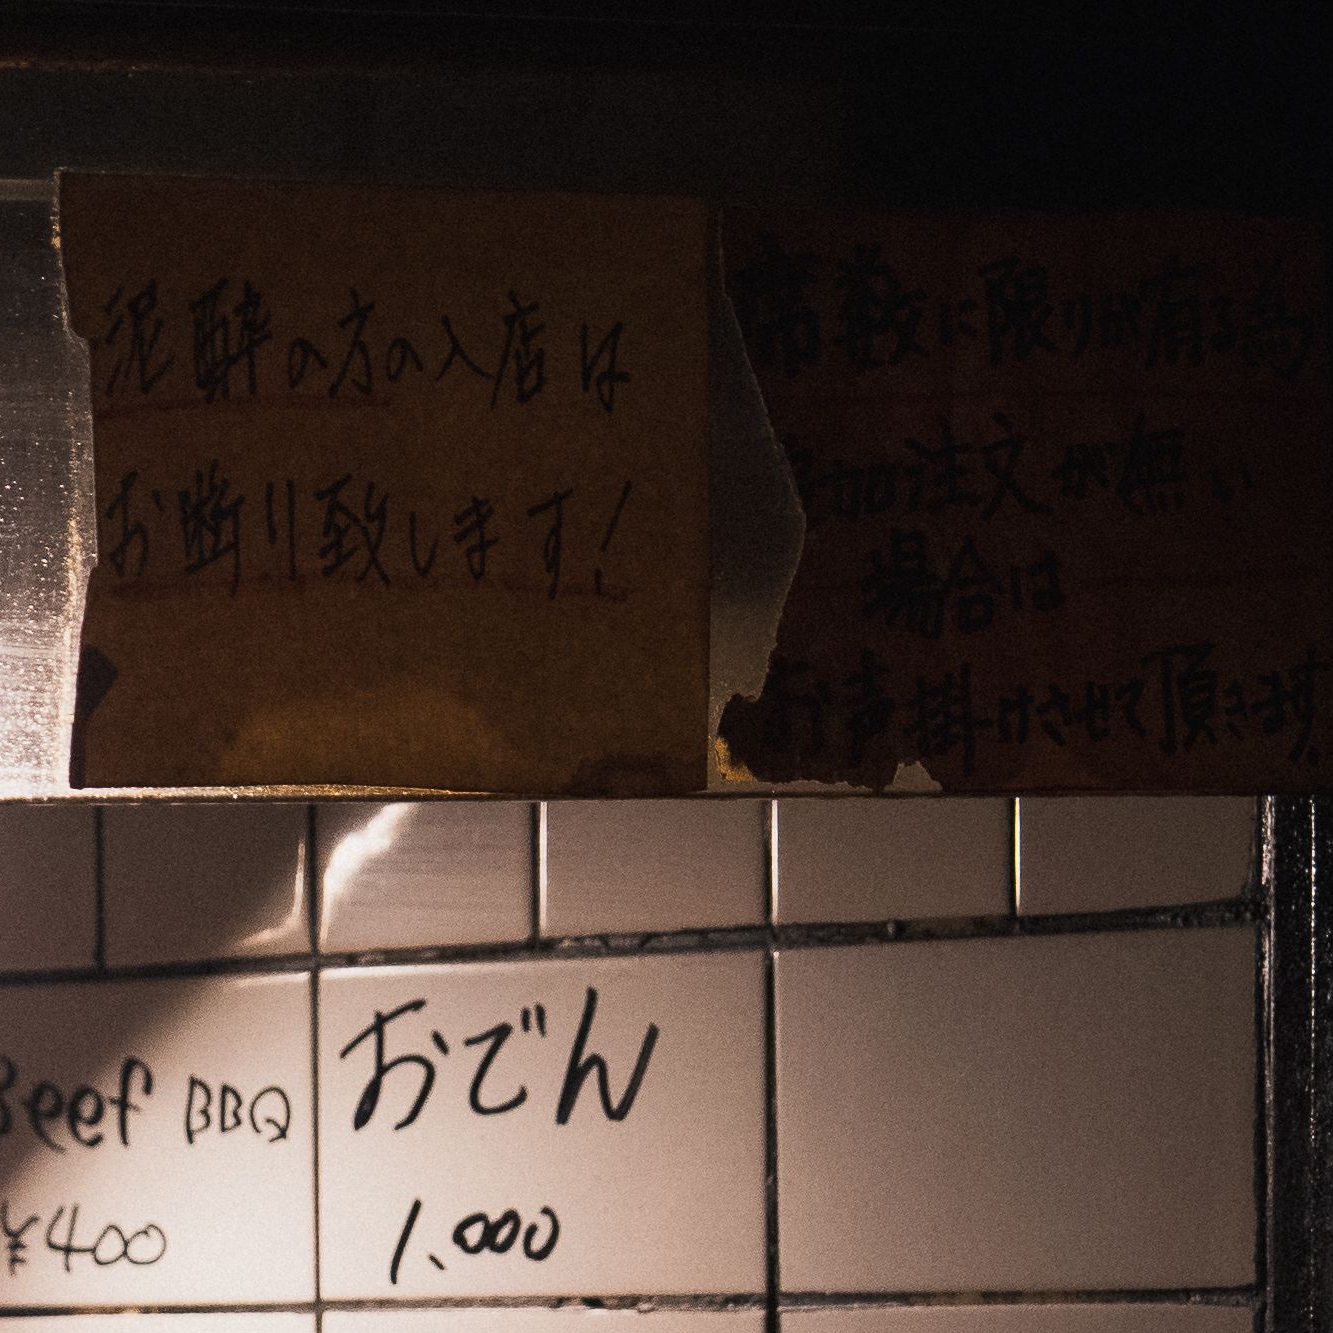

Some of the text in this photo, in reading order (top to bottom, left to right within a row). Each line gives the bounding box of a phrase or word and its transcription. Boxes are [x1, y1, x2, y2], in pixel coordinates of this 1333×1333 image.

[340, 985, 661, 1132] おでん
[184, 1072, 293, 1146] BBQ
[0, 1202, 167, 1277] ¥400
